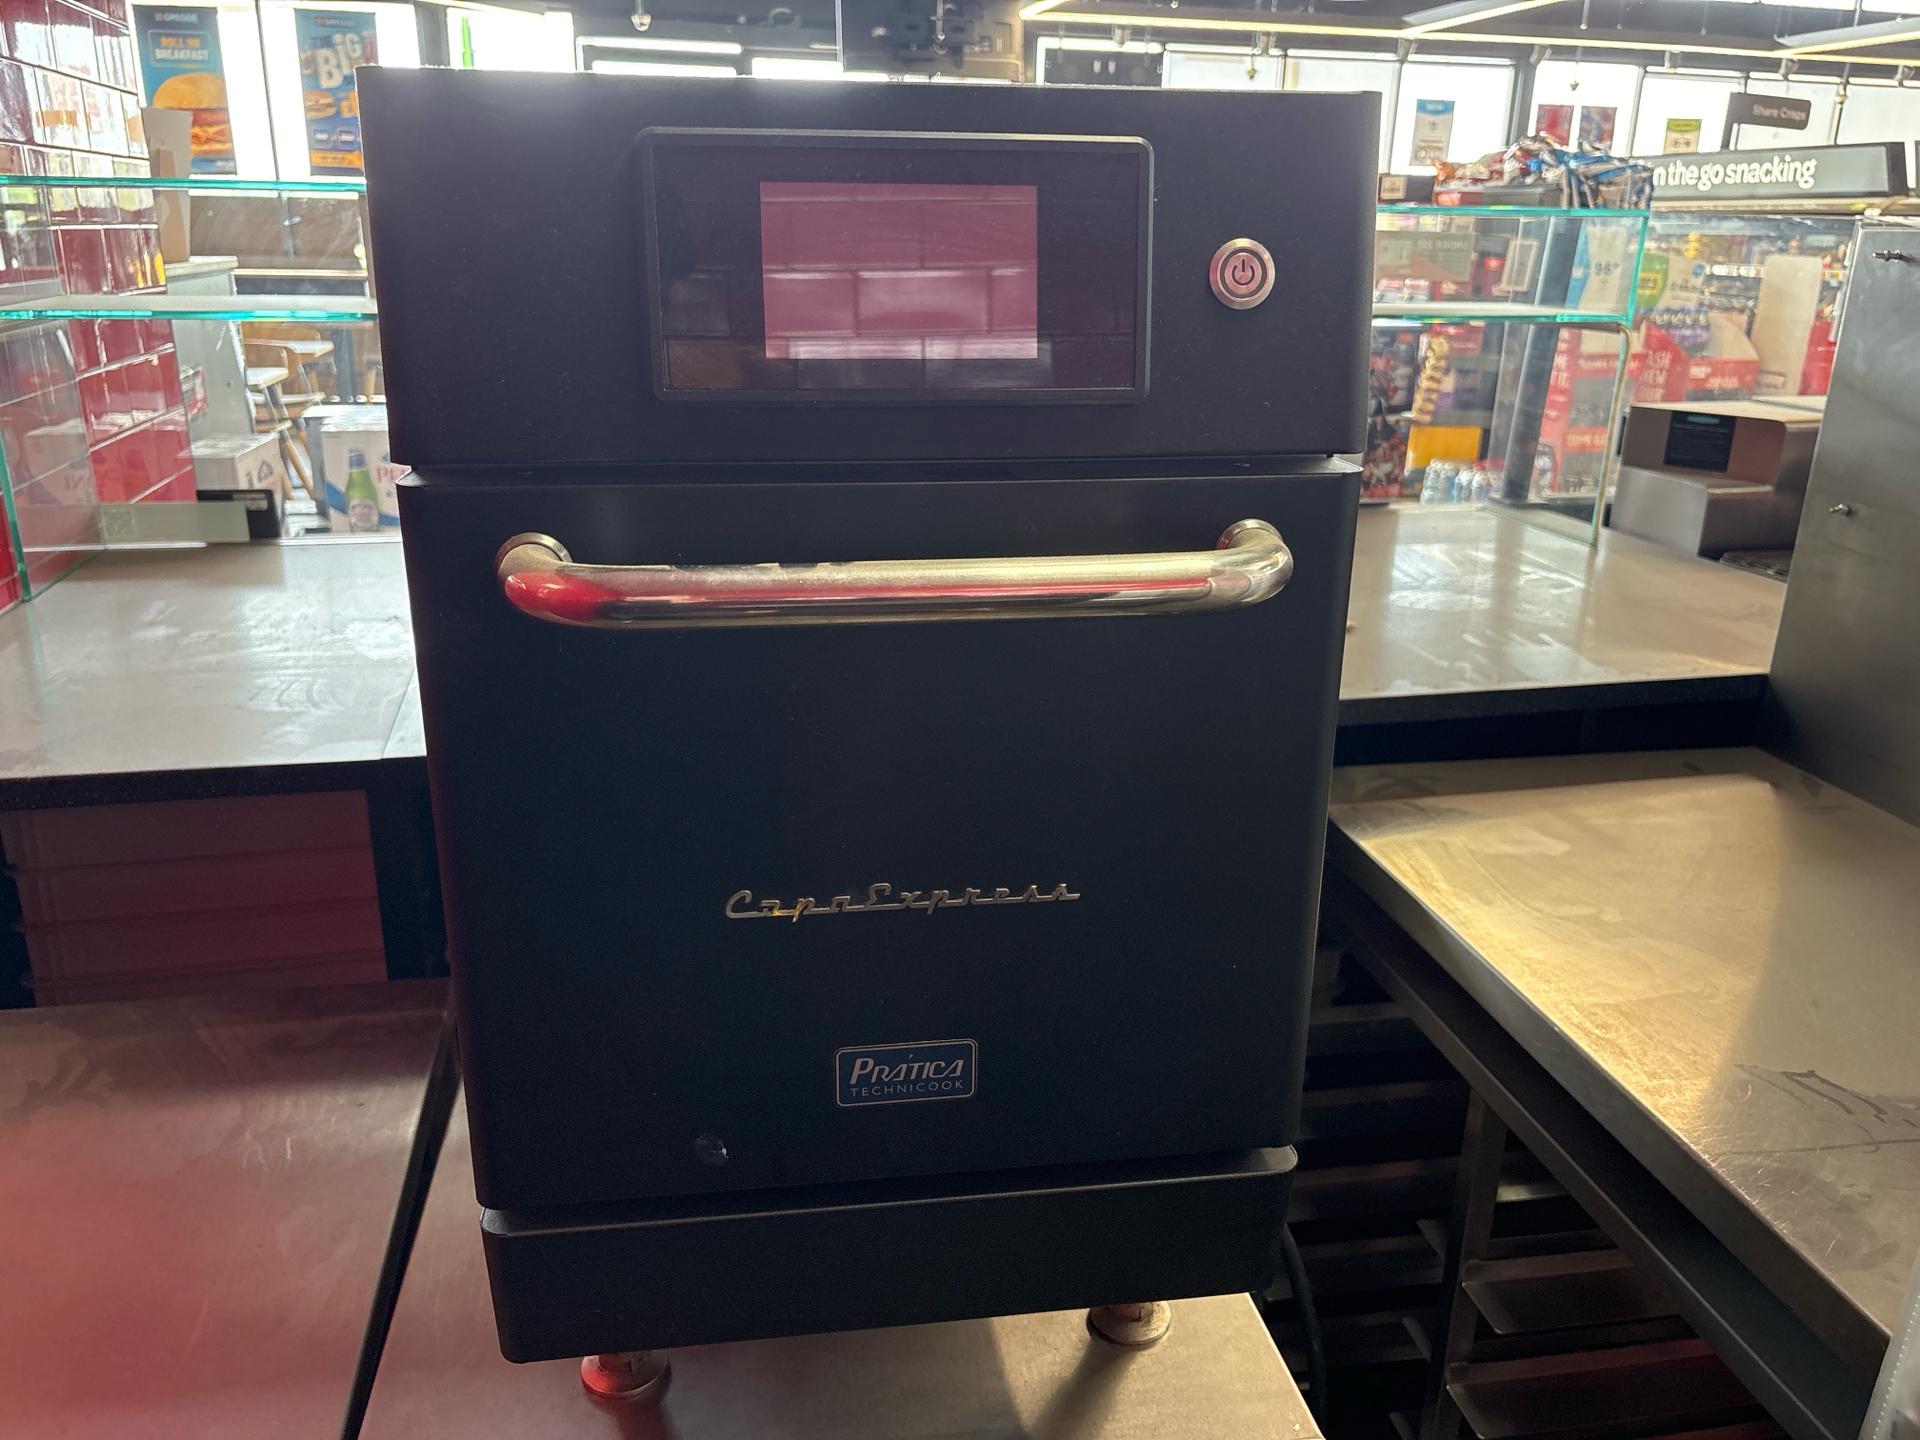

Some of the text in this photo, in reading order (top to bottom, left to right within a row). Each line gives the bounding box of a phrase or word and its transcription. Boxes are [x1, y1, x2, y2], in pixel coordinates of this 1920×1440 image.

[154, 48, 209, 60] BREAKFAST
[1752, 103, 1779, 118] Share
[1653, 154, 1818, 192] n the go snacking
[849, 1079, 964, 1097] TECHNICOOK
